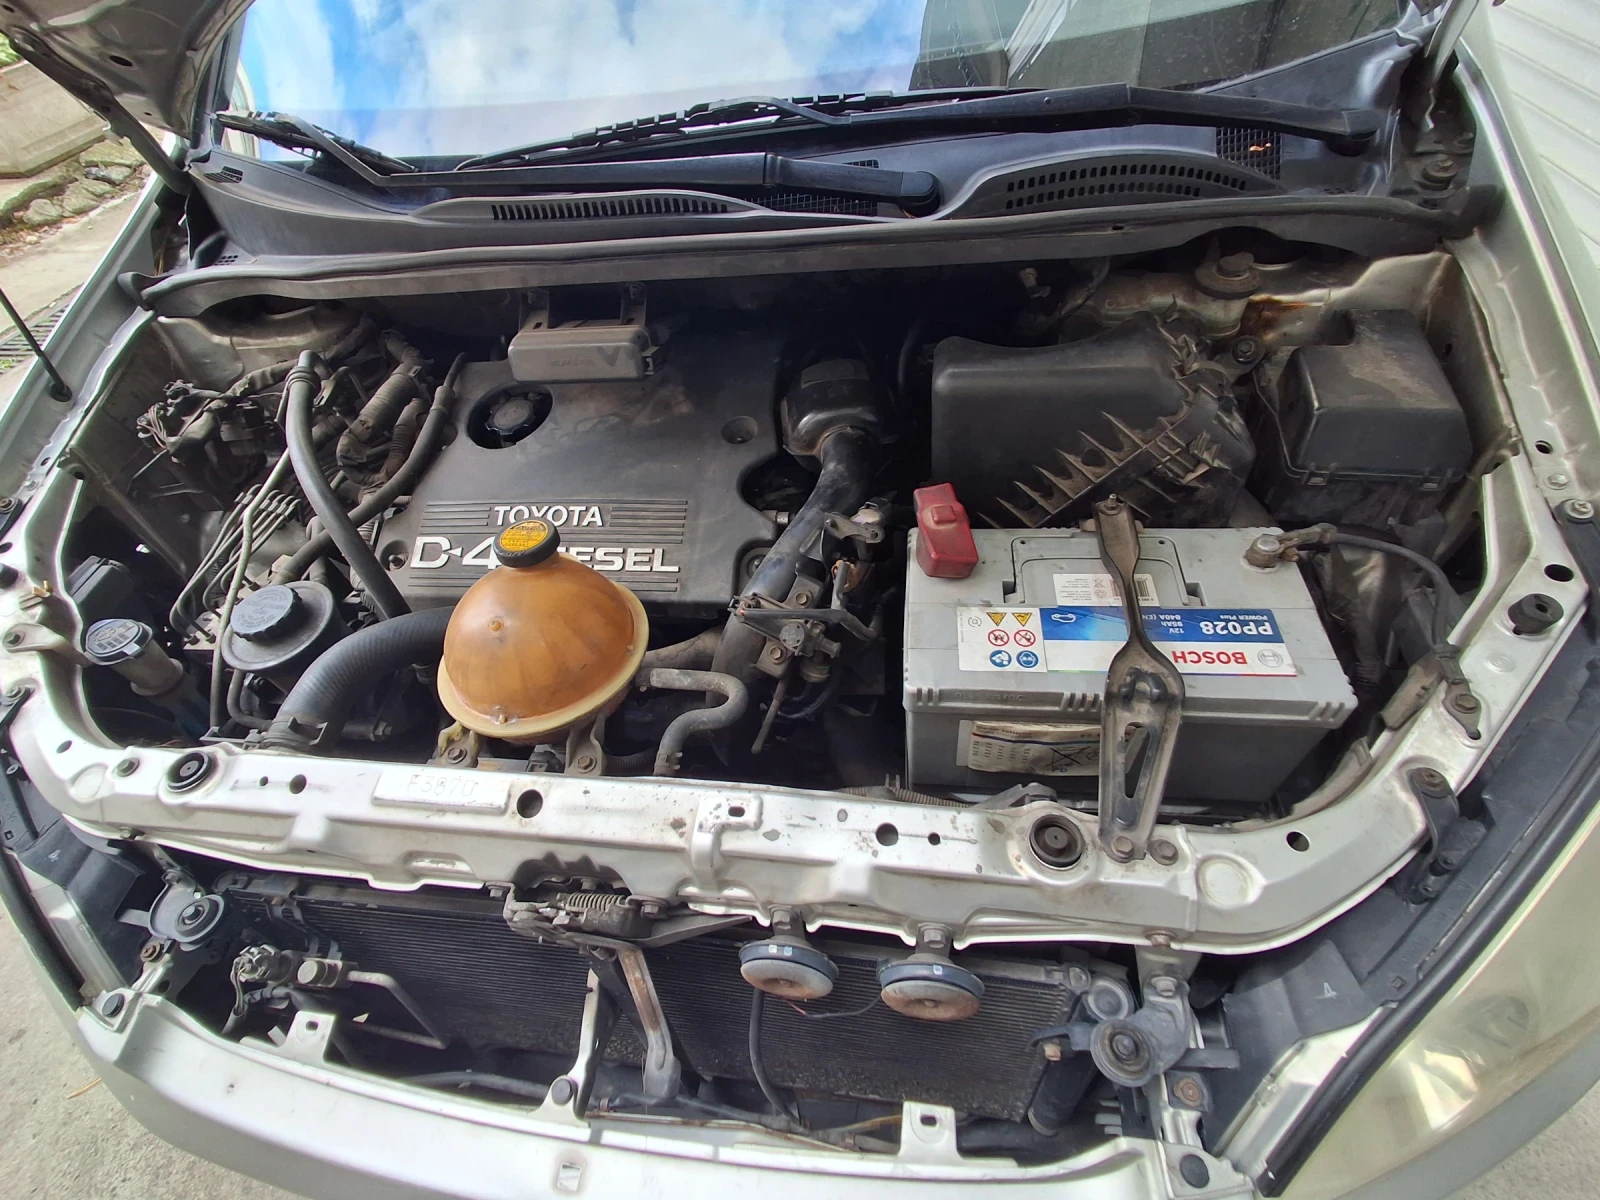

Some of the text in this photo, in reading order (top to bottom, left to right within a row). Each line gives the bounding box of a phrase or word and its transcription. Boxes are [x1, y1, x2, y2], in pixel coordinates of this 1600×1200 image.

[494, 505, 603, 527] TOYOTA
[557, 547, 680, 572] ESEL
[1158, 613, 1181, 621] 840A
[1161, 620, 1183, 628] 95Ah
[1199, 621, 1274, 636] PP028
[1171, 650, 1248, 665] BOSCH
